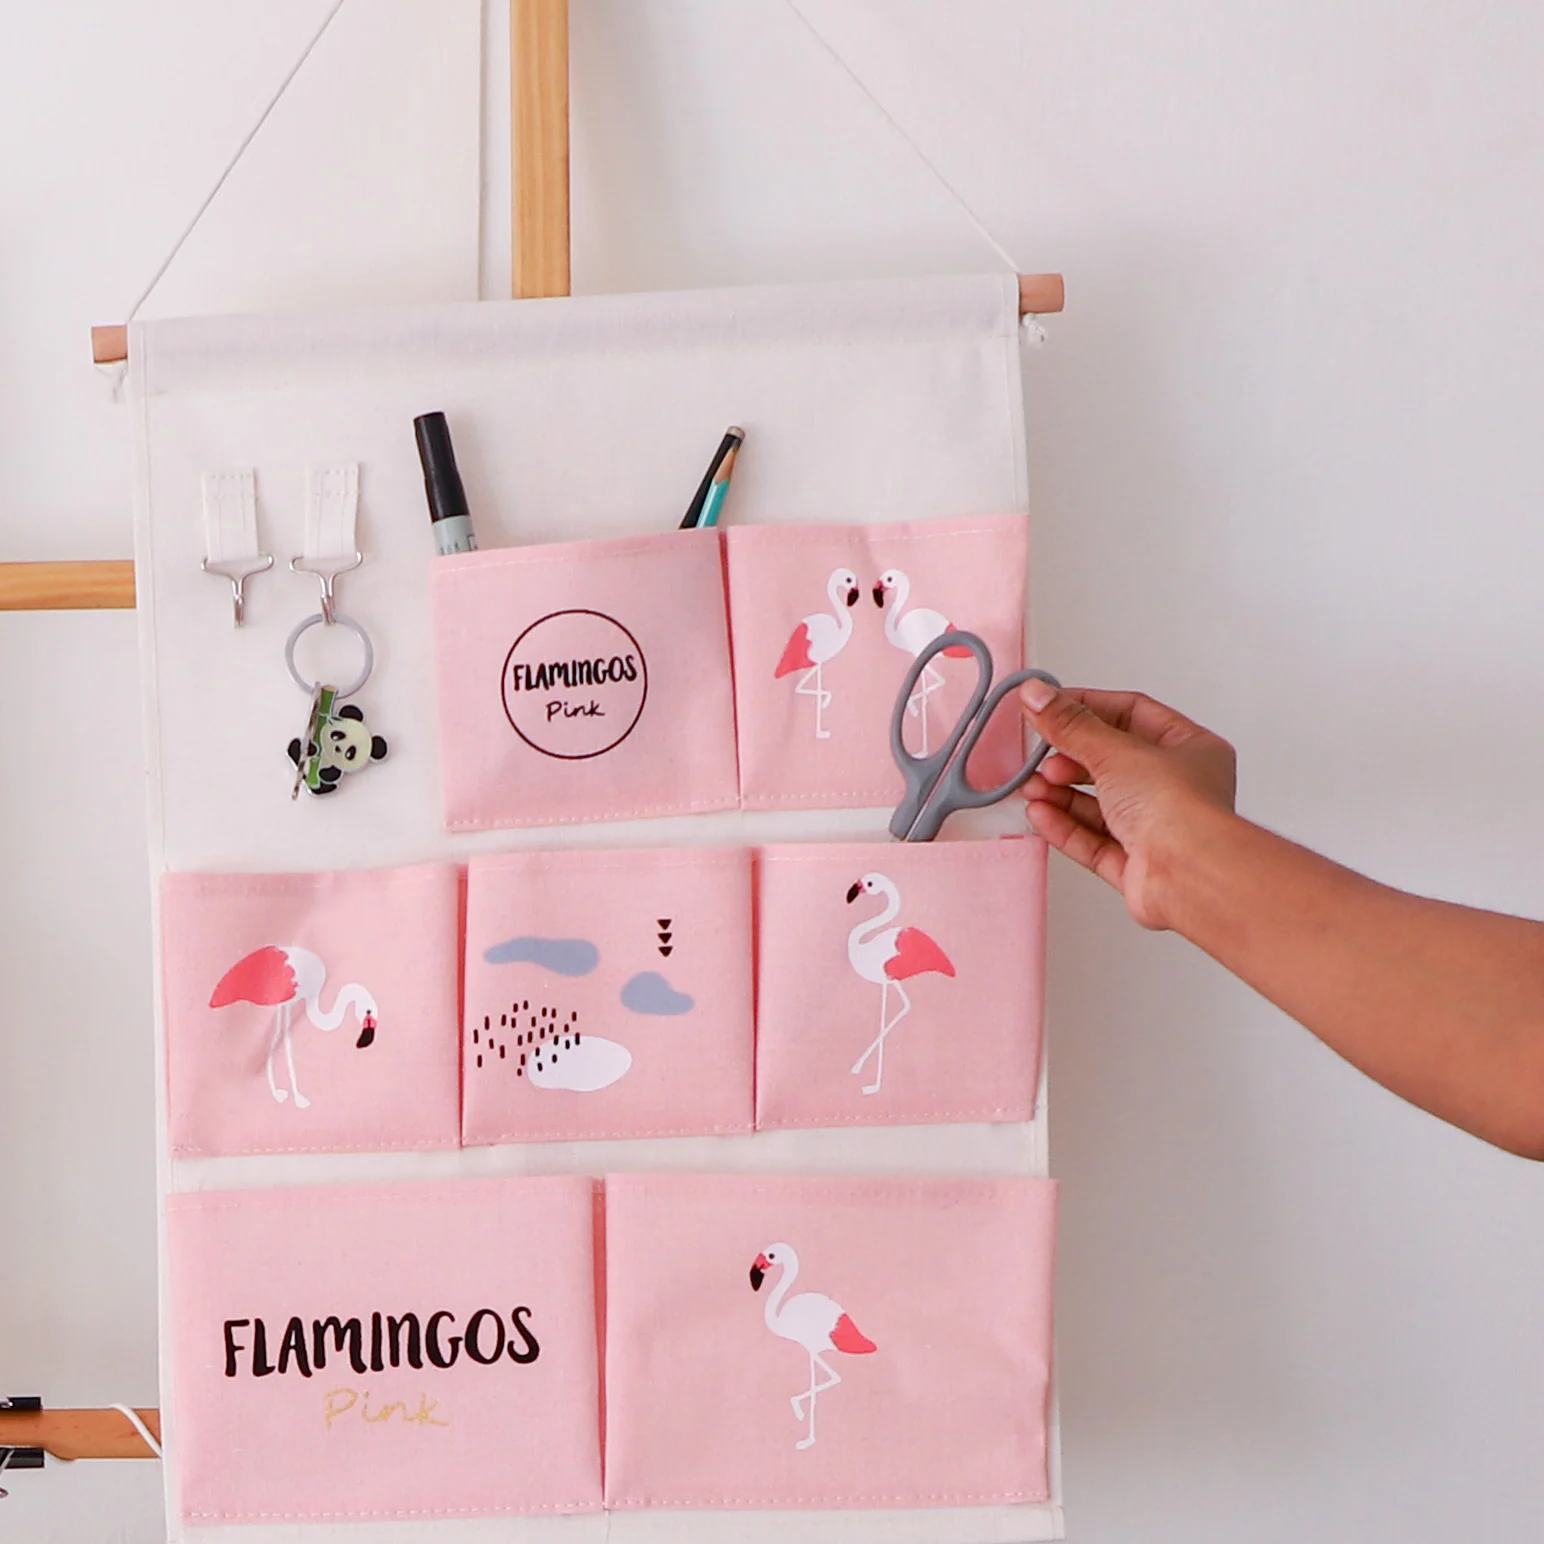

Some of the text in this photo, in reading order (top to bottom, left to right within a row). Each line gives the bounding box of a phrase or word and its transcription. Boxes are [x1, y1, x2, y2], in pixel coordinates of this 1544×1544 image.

[513, 655, 637, 691] FLAMINGOS
[546, 700, 605, 722] Pink
[224, 1306, 540, 1377] FLAMINGOS
[323, 1388, 449, 1430] Pink
